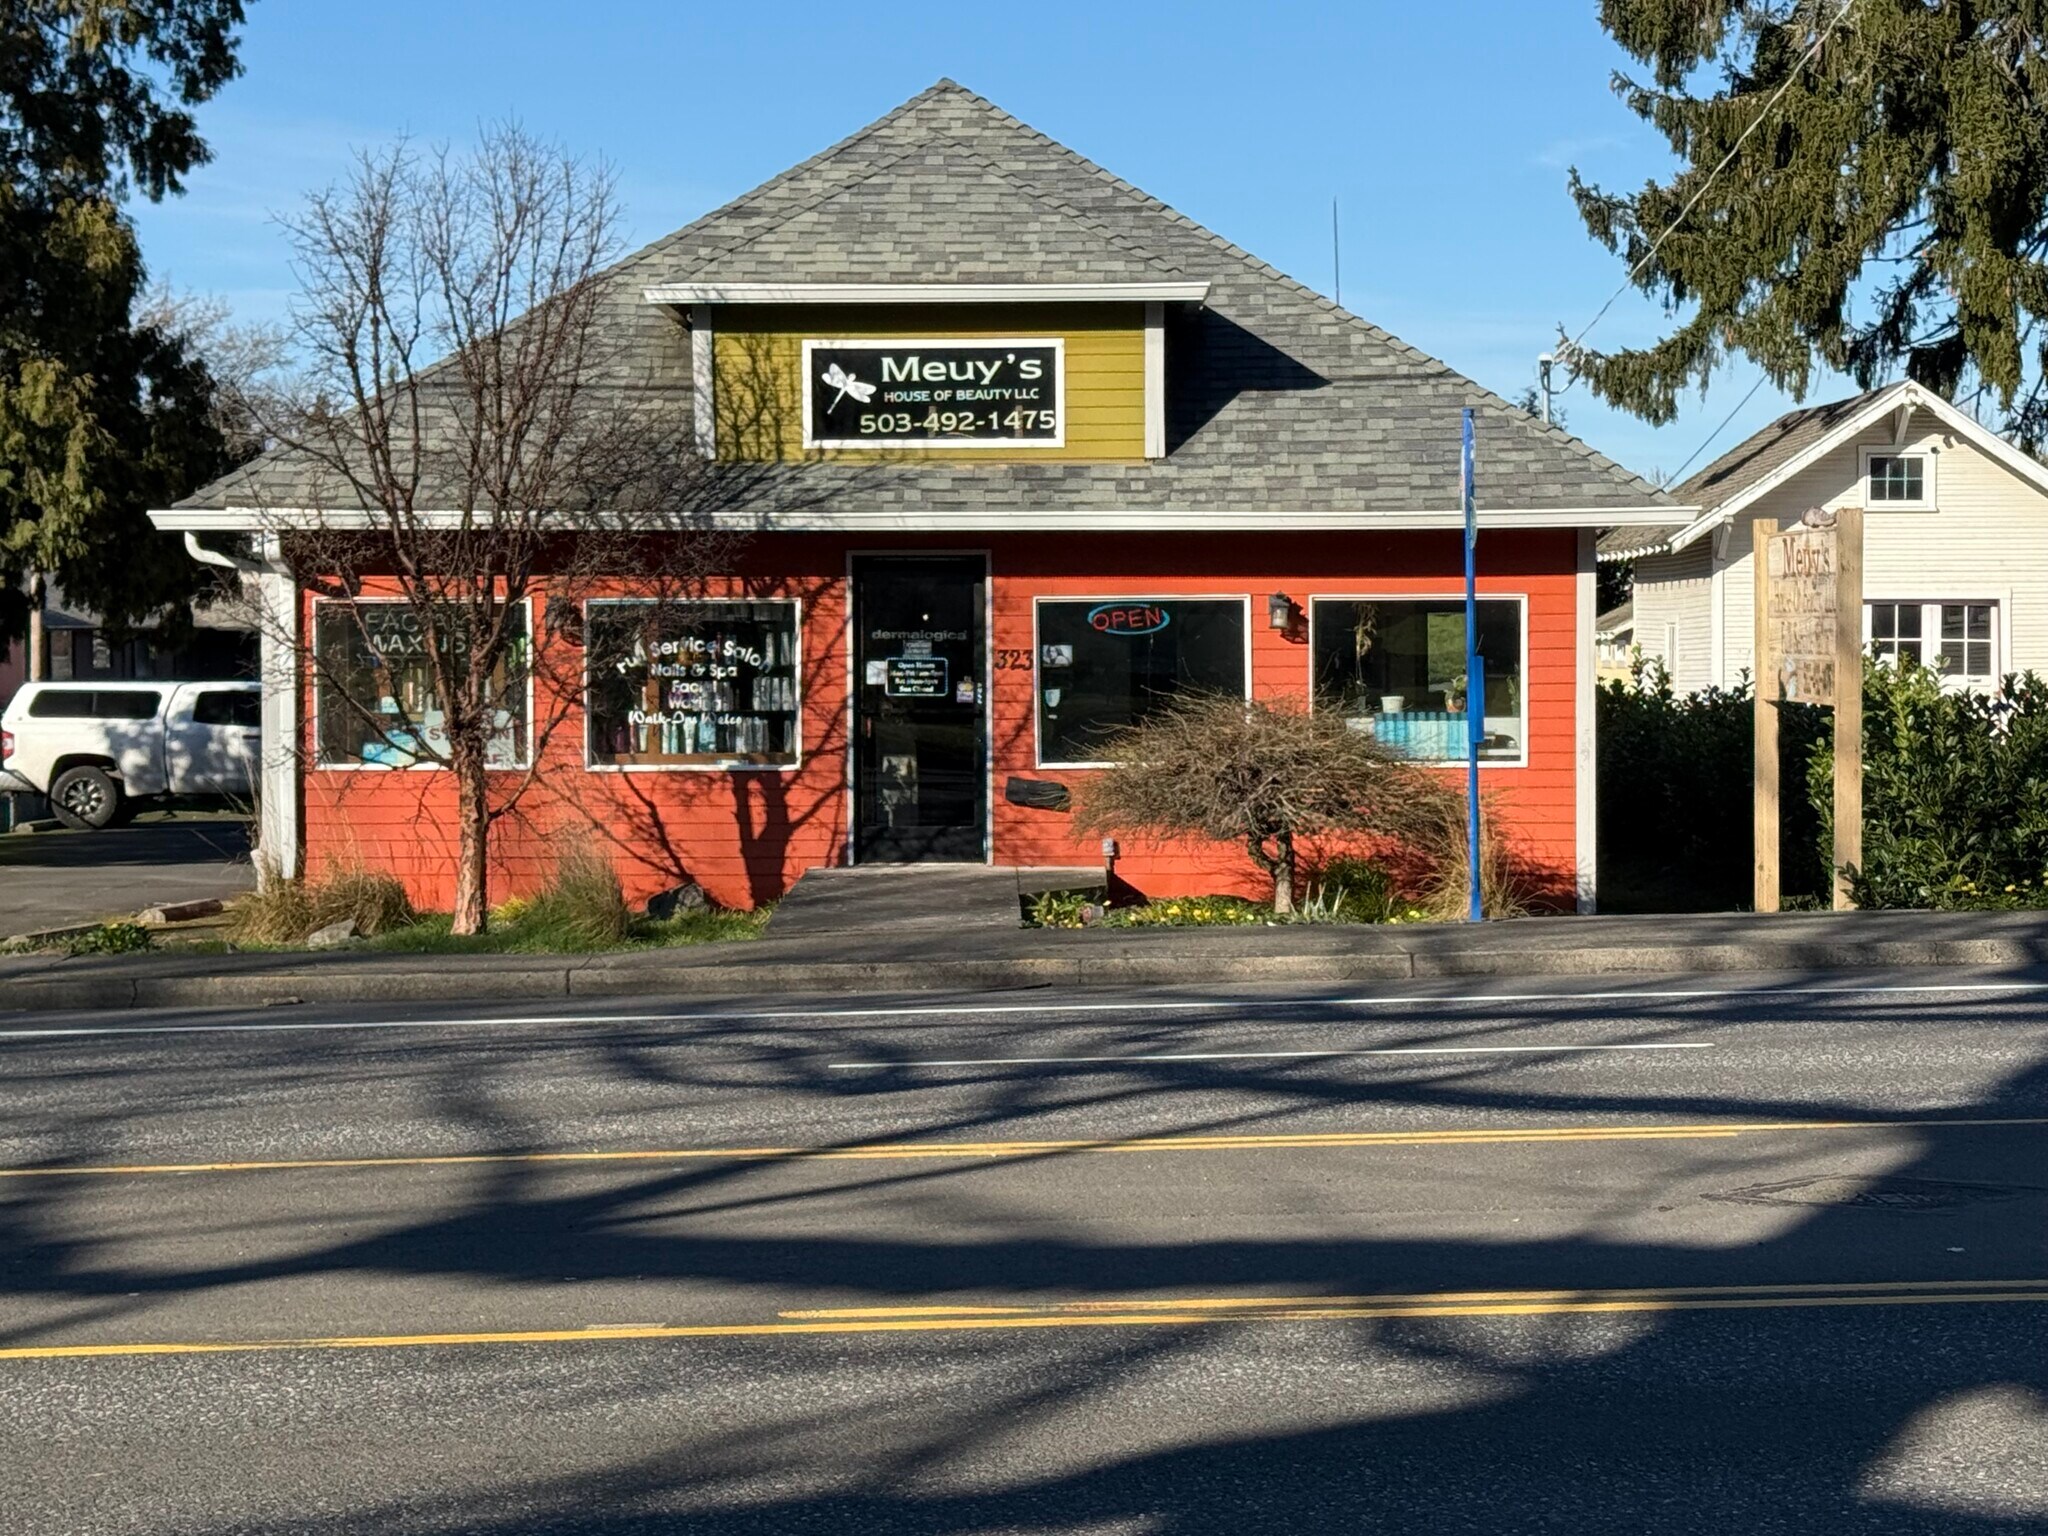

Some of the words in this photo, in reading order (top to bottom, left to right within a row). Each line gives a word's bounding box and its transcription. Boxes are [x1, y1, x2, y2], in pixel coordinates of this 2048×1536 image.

[881, 353, 1042, 385] Meuy's
[884, 390, 930, 403] HOUSE
[934, 390, 952, 402] OF
[956, 389, 1012, 401] BEAUTY
[1014, 388, 1040, 400] LLC
[860, 410, 1055, 433] 503-492-1475
[1092, 607, 1161, 631] OPEN
[872, 630, 967, 642] dermalogica
[650, 636, 719, 657] Service
[723, 641, 772, 673] Salon
[995, 650, 1033, 671] 323
[651, 663, 686, 676] Nails
[709, 664, 738, 679] Spa
